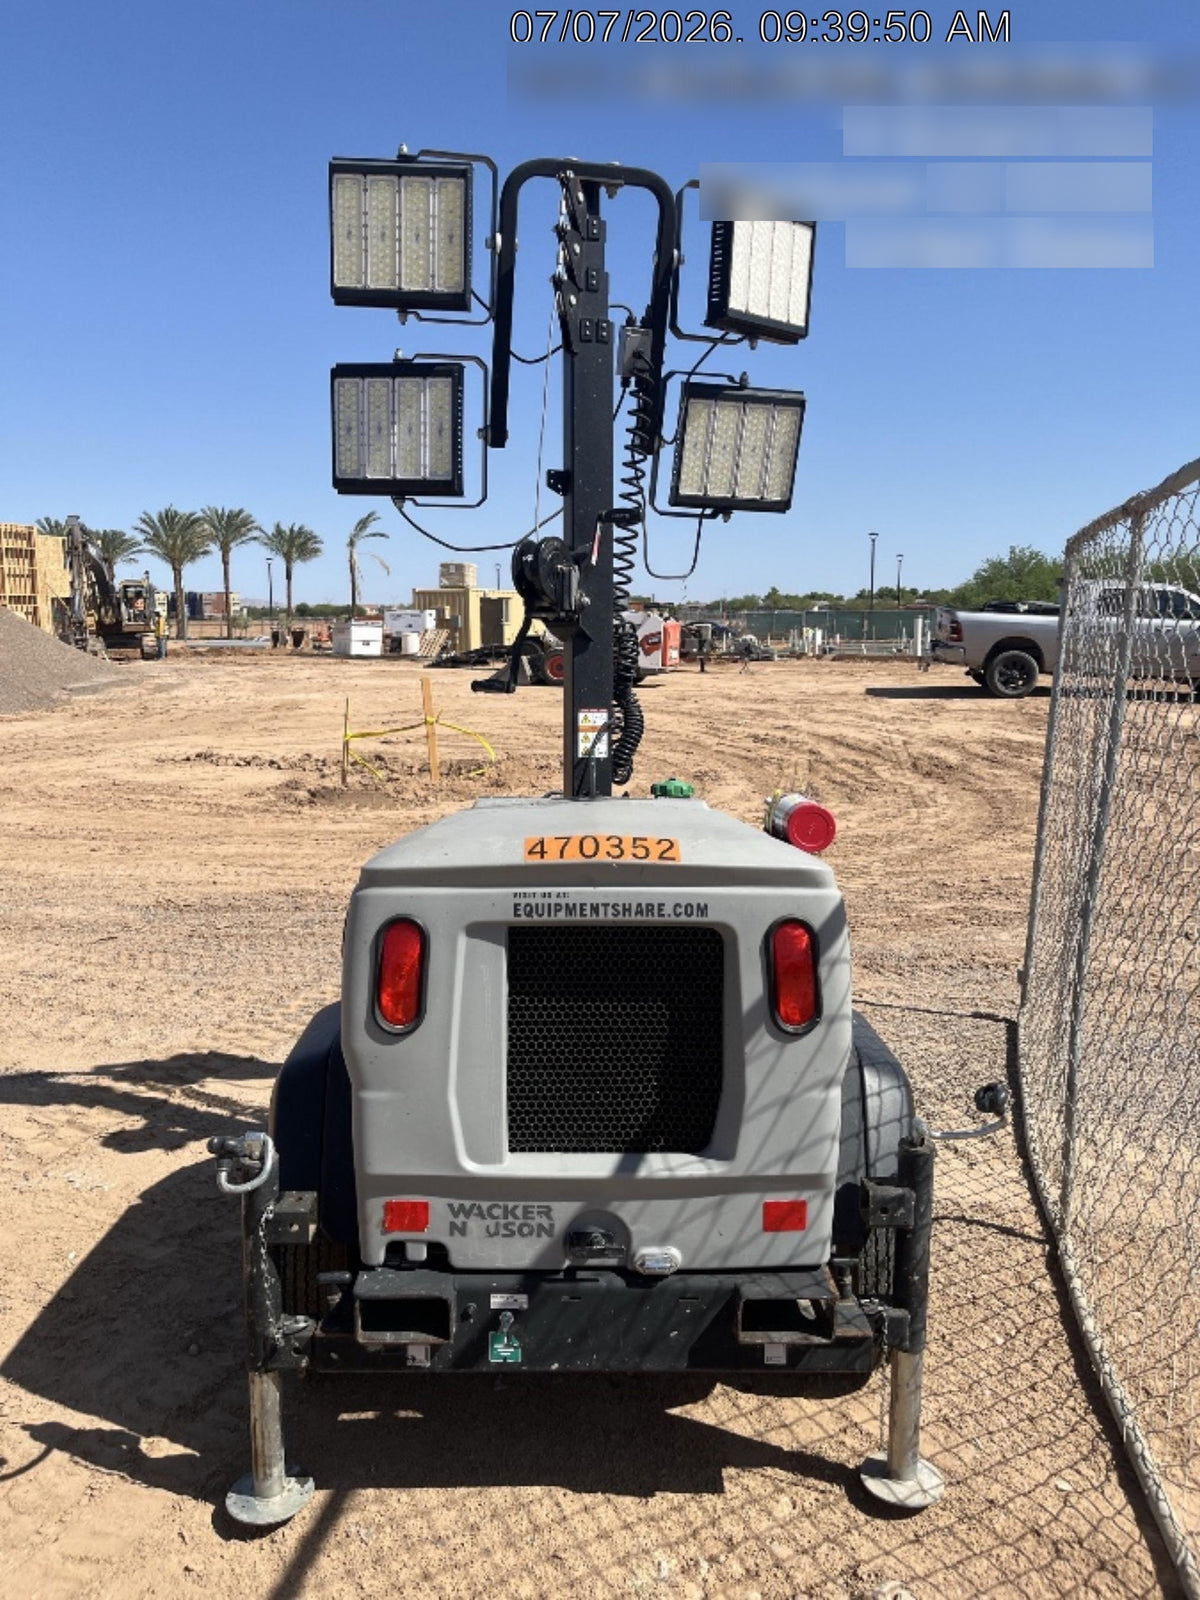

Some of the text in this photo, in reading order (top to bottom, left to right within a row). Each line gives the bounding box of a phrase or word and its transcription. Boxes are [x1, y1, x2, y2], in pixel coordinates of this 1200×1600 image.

[527, 835, 677, 861] 470352
[512, 902, 709, 919] EQUIPMENTSHARE.COM
[447, 1203, 554, 1221] WACKER
[448, 1221, 555, 1238] NUSON
